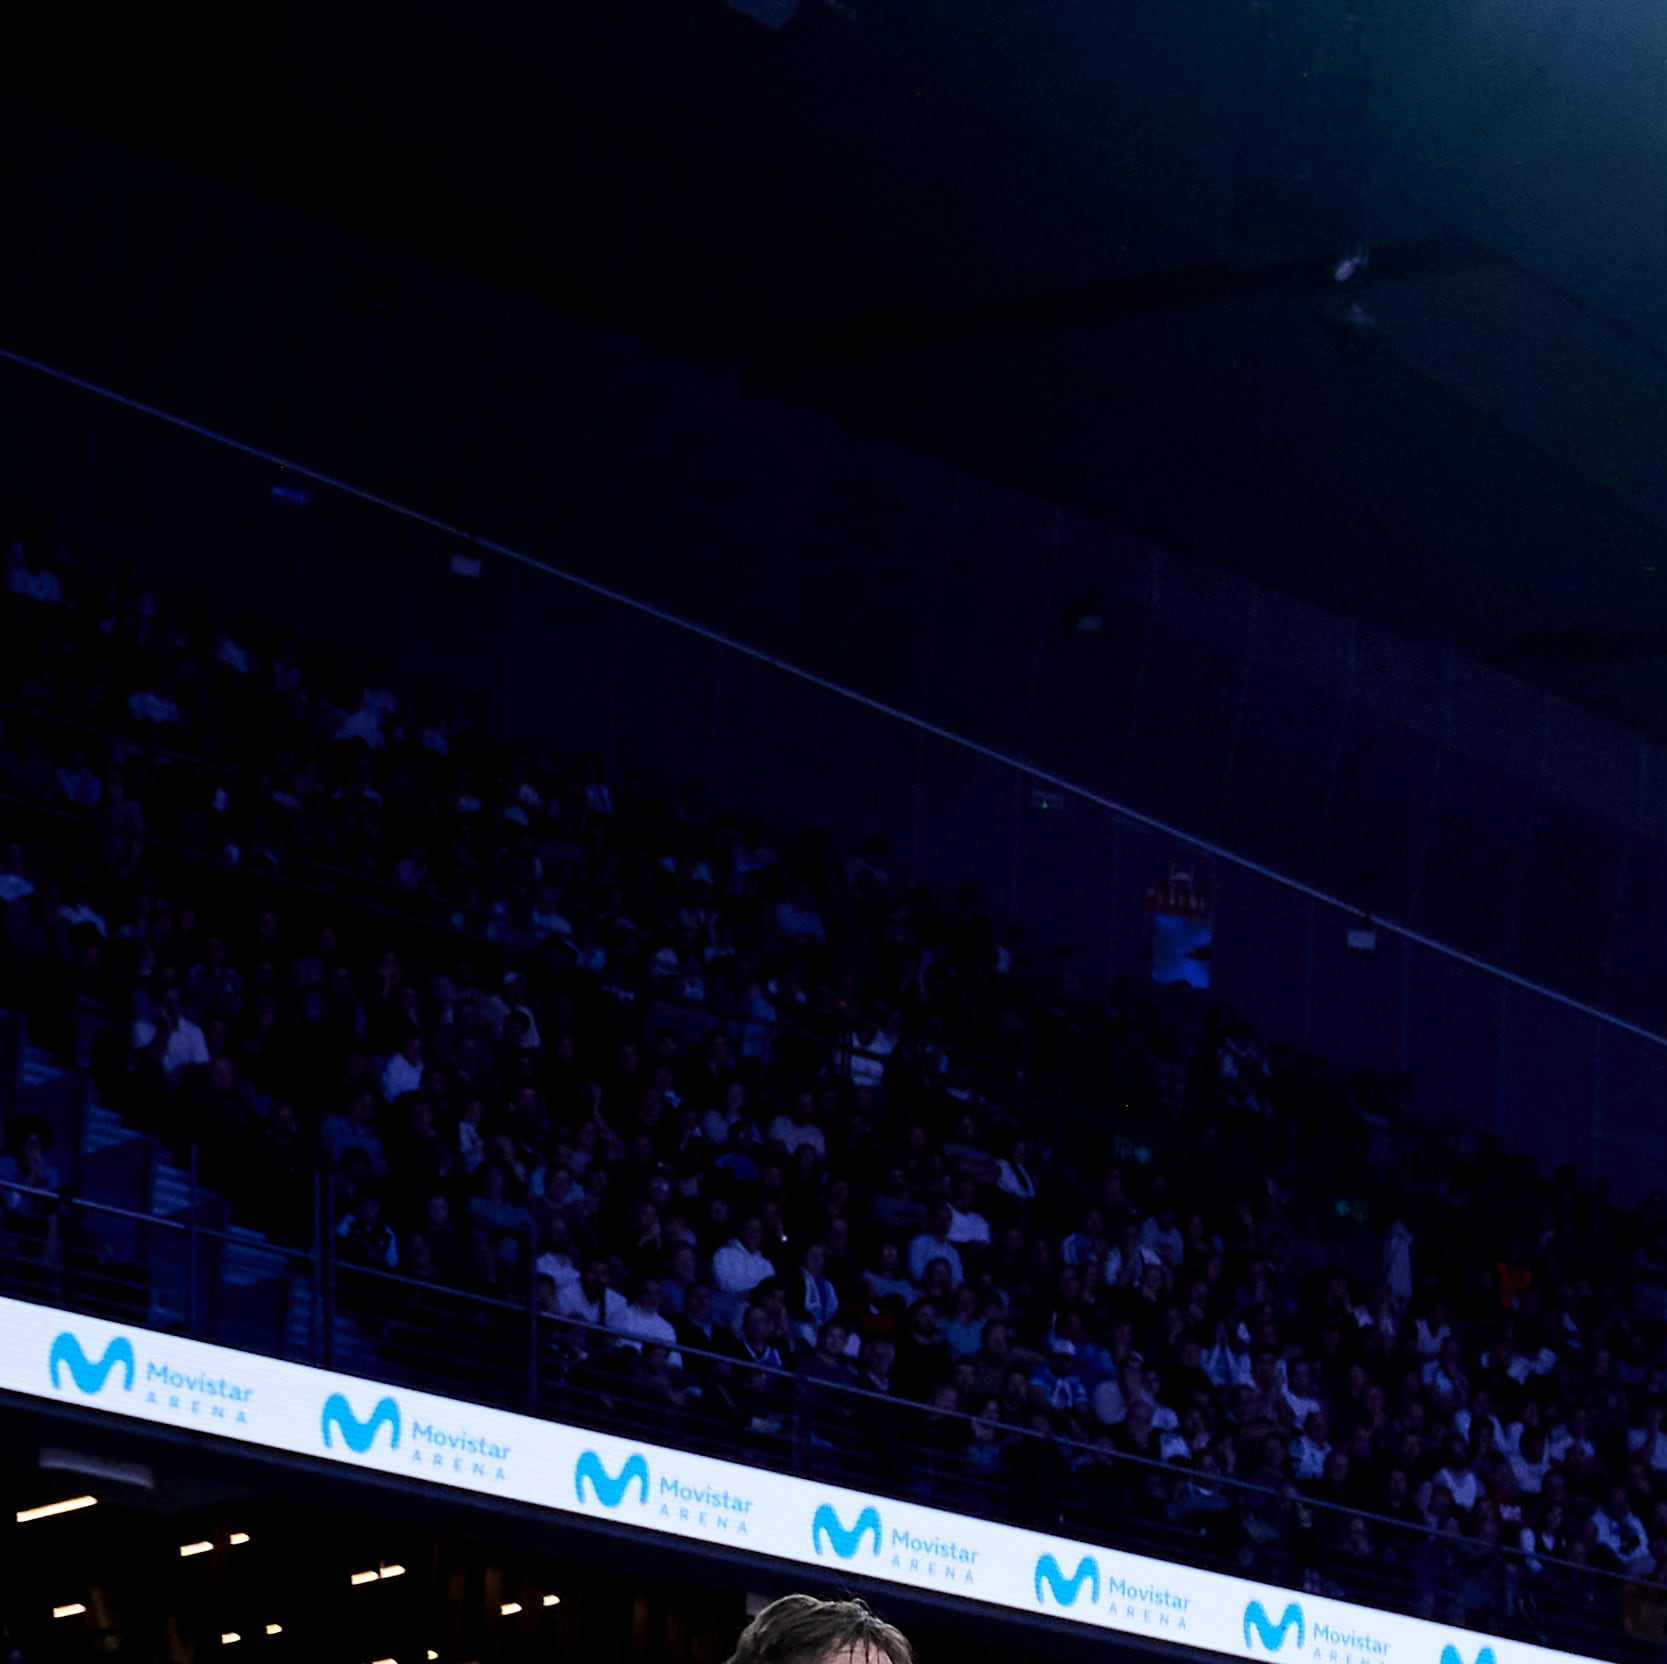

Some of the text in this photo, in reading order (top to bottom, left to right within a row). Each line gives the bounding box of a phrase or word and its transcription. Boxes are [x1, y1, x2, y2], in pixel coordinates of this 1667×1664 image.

[145, 1360, 253, 1405] Movistar
[145, 1390, 249, 1425] ARENA
[411, 1420, 511, 1462] Movistar
[412, 1449, 507, 1482] ARENA
[659, 1475, 753, 1516] Movistar
[659, 1502, 748, 1535] ARENA
[891, 1527, 980, 1563] Movistar
[892, 1554, 975, 1584] ARENA
[1110, 1575, 1191, 1613] Movistar
[1110, 1601, 1188, 1631] ARENA
[1312, 1622, 1391, 1656] Movistar
